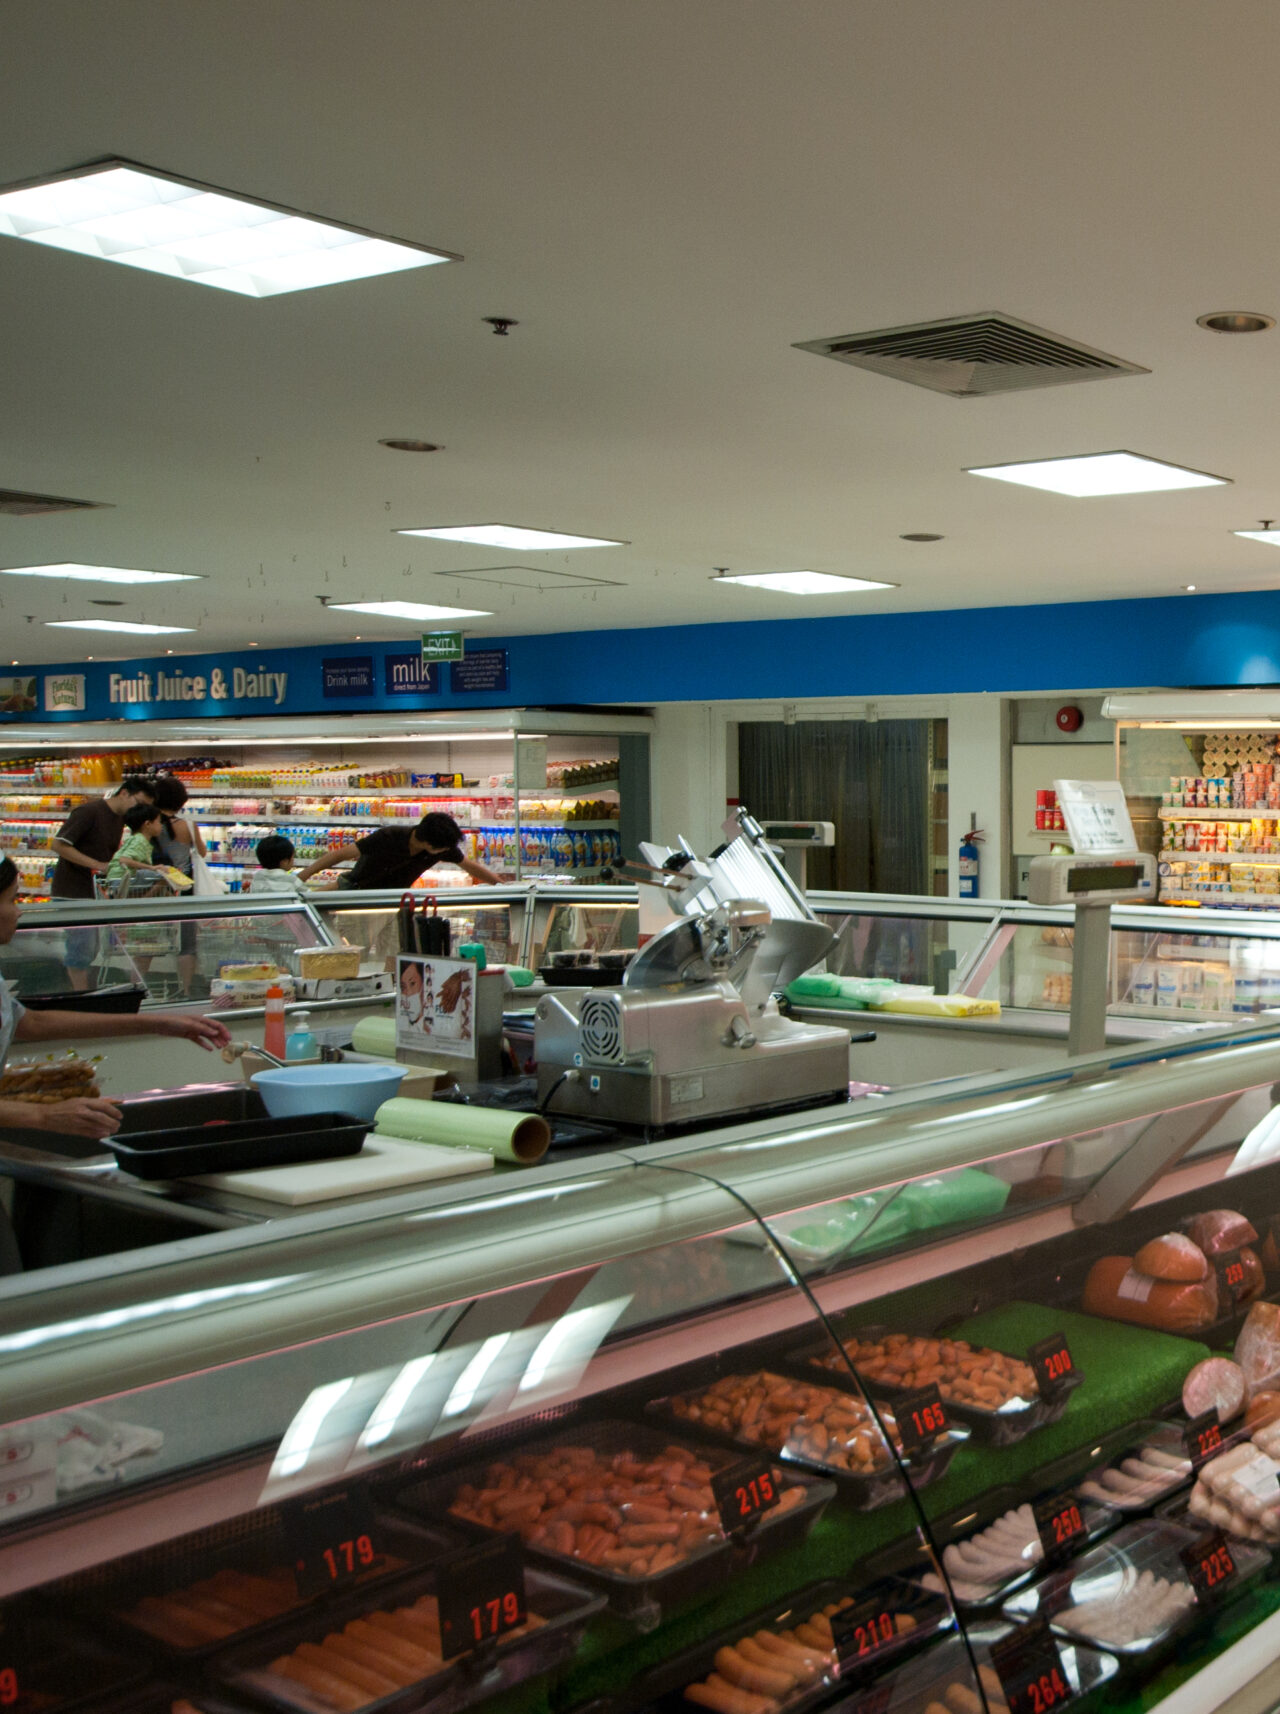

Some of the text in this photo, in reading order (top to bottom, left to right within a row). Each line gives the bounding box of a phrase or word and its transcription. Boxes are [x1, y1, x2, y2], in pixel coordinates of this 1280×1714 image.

[428, 638, 450, 656] EXIT
[109, 665, 288, 704] Fruit Juice & Dairy
[327, 673, 369, 687] Drink milk
[393, 656, 431, 682] milk
[1045, 1349, 1071, 1379] 200
[912, 1402, 945, 1436] 165
[735, 1472, 774, 1516] 215
[1052, 1506, 1083, 1544] 250
[323, 1534, 374, 1579] 179
[1201, 1546, 1233, 1587] 225
[470, 1592, 519, 1640] 179
[855, 1613, 893, 1656] 210
[1027, 1667, 1064, 1713] 264
